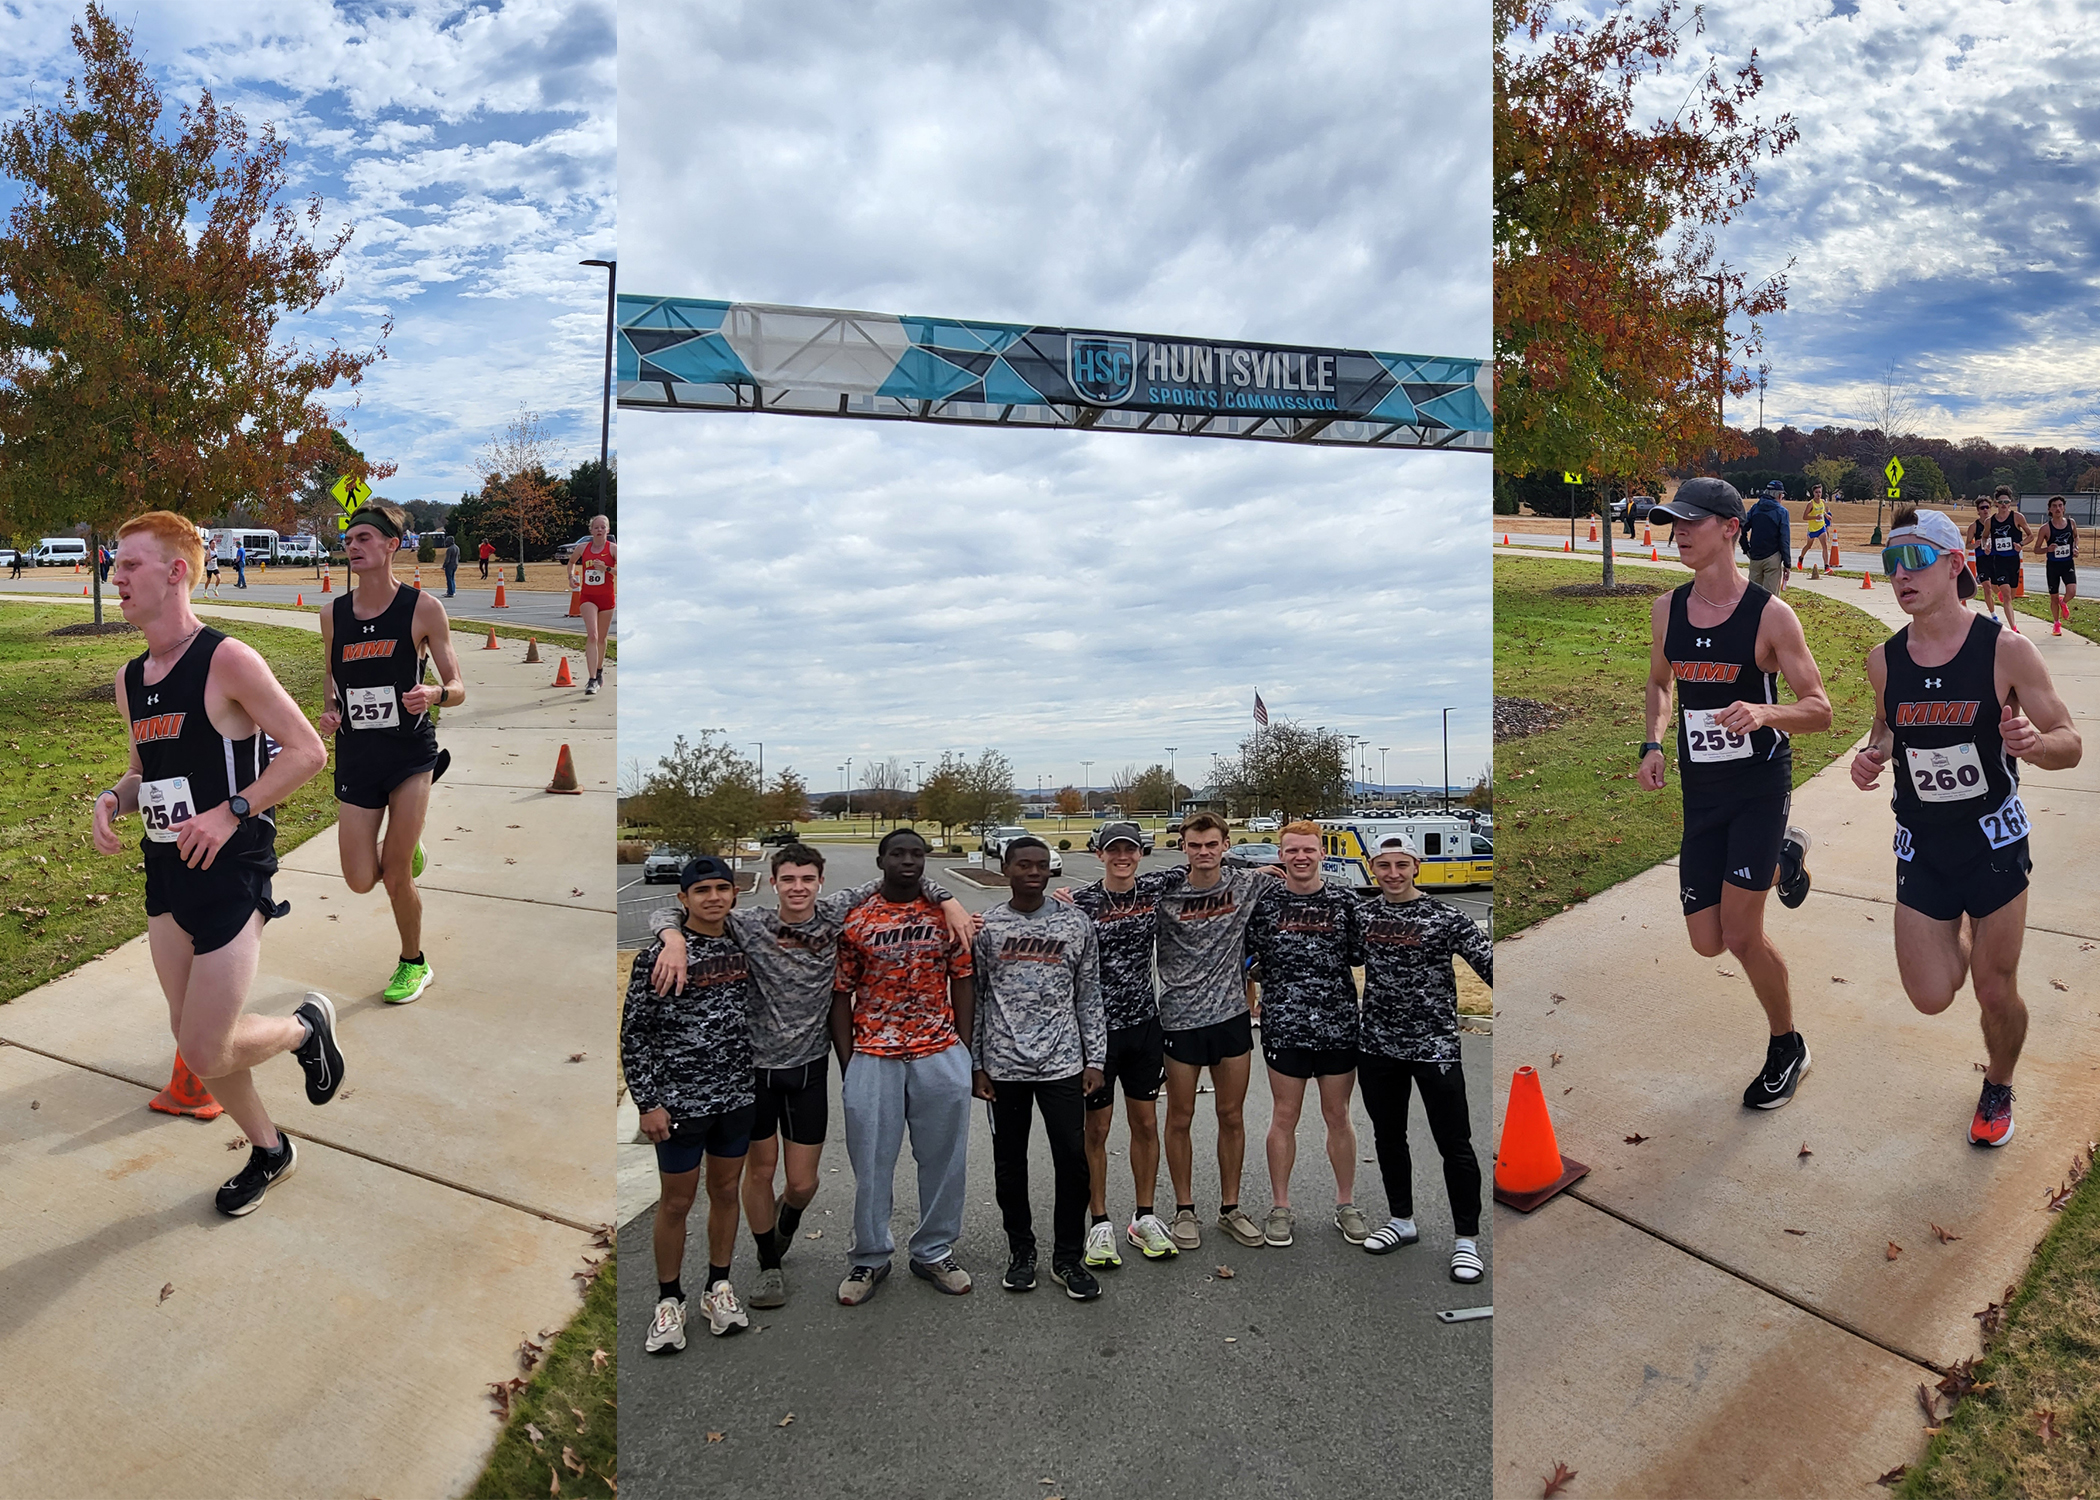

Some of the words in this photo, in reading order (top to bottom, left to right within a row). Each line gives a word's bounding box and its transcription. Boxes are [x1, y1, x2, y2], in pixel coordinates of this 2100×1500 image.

[1073, 349, 1131, 387] HSC
[1147, 342, 1336, 392] HUNTSVILLE
[1148, 386, 1219, 409] SPORTS
[1224, 392, 1339, 411] COMMISSION
[342, 639, 398, 663] MMI
[1671, 660, 1742, 684] MMI
[350, 702, 393, 721] 257
[1896, 700, 1982, 727] MMI
[1690, 729, 1745, 752] 259
[1915, 764, 1980, 791] 260
[142, 801, 192, 830] 254
[874, 925, 936, 948] MMI
[1002, 937, 1068, 955] MMI
